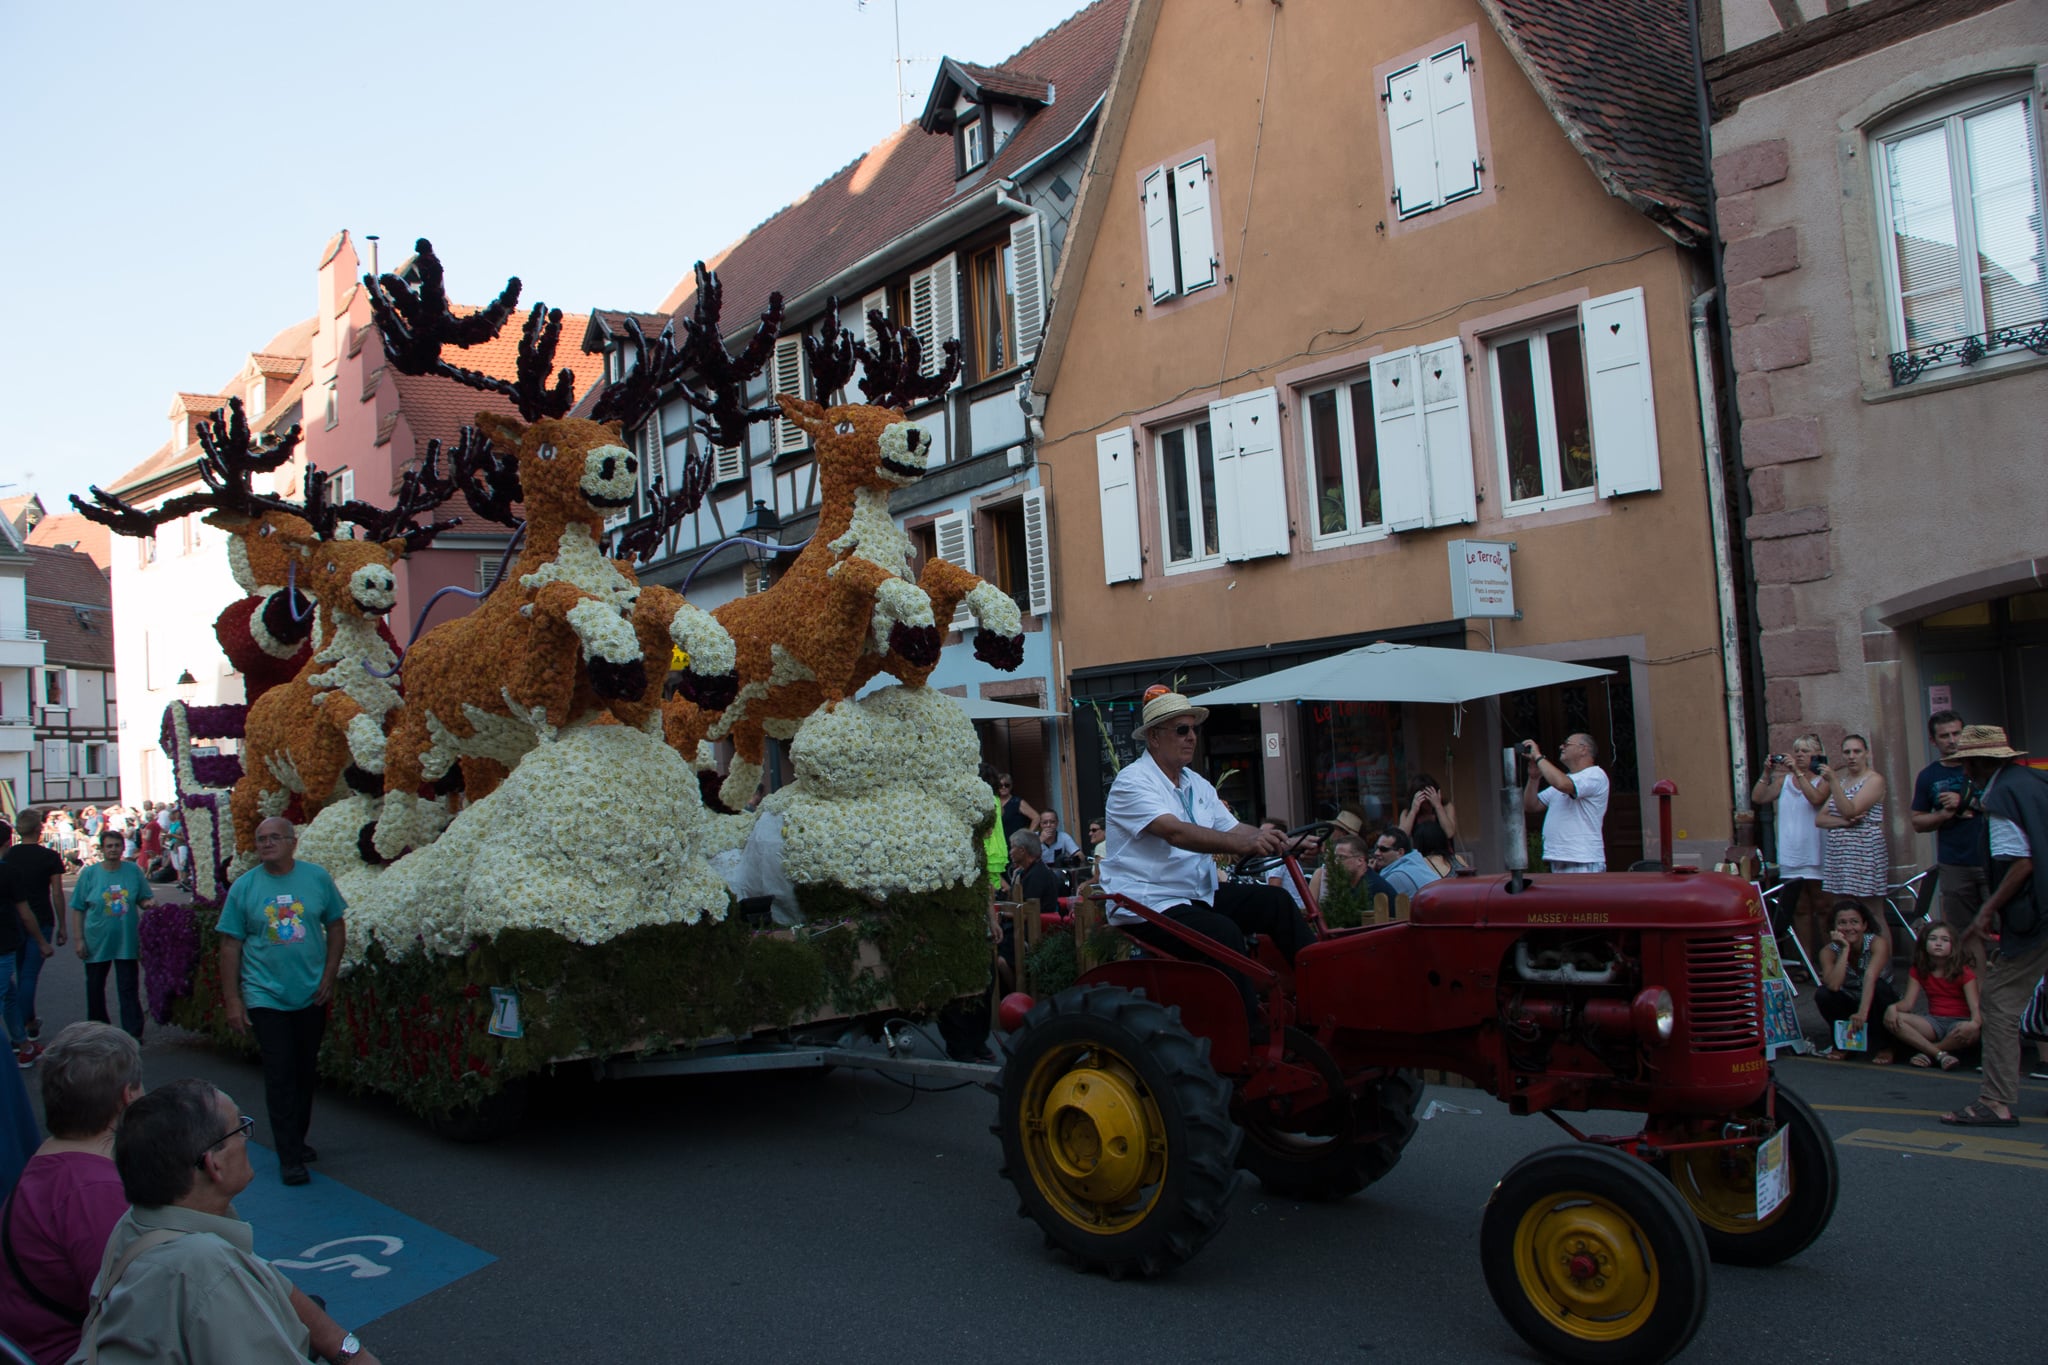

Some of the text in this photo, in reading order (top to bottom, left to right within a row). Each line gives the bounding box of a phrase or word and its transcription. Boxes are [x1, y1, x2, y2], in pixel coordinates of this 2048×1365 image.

[1466, 550, 1503, 565] Le Terroir
[1313, 704, 1331, 724] Le
[1527, 912, 1609, 923] MASSEY-HARRIS
[500, 998, 509, 1024] 7
